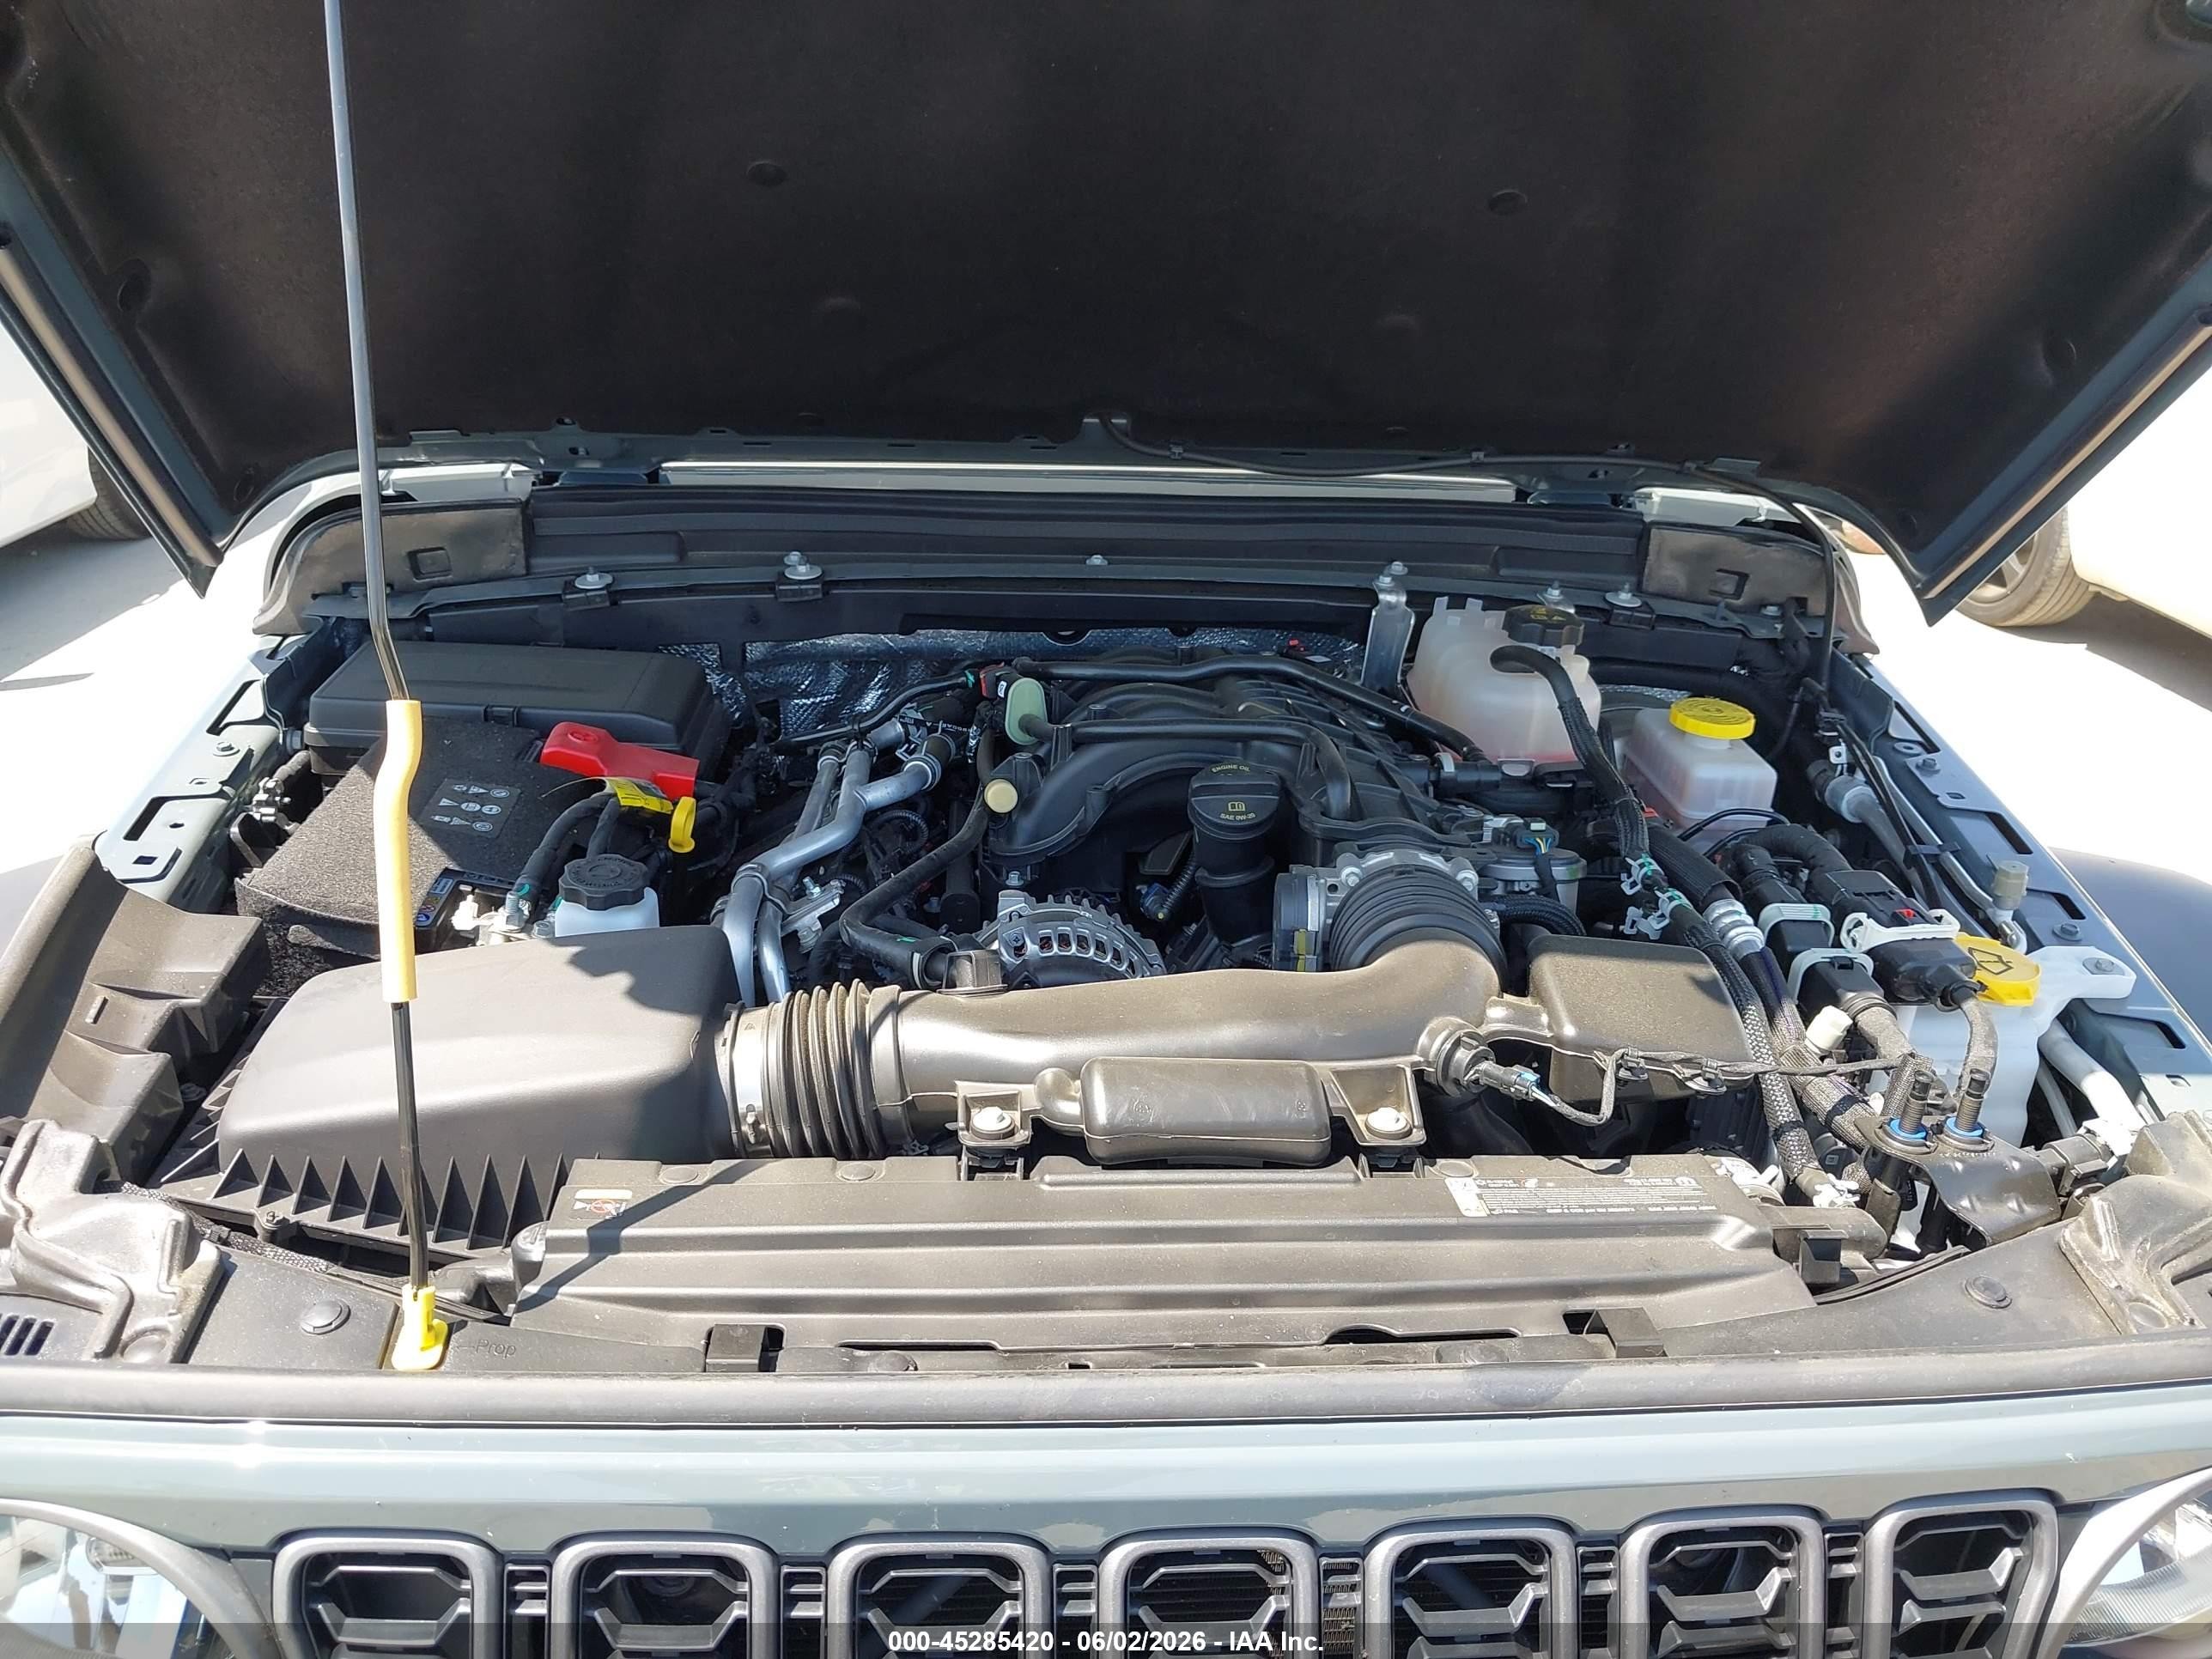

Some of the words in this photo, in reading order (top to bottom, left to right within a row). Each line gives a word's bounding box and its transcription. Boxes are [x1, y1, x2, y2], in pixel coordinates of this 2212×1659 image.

[1211, 764, 1237, 773] ENGINE
[1220, 812, 1235, 821] SAE
[476, 1339, 516, 1358] Prop
